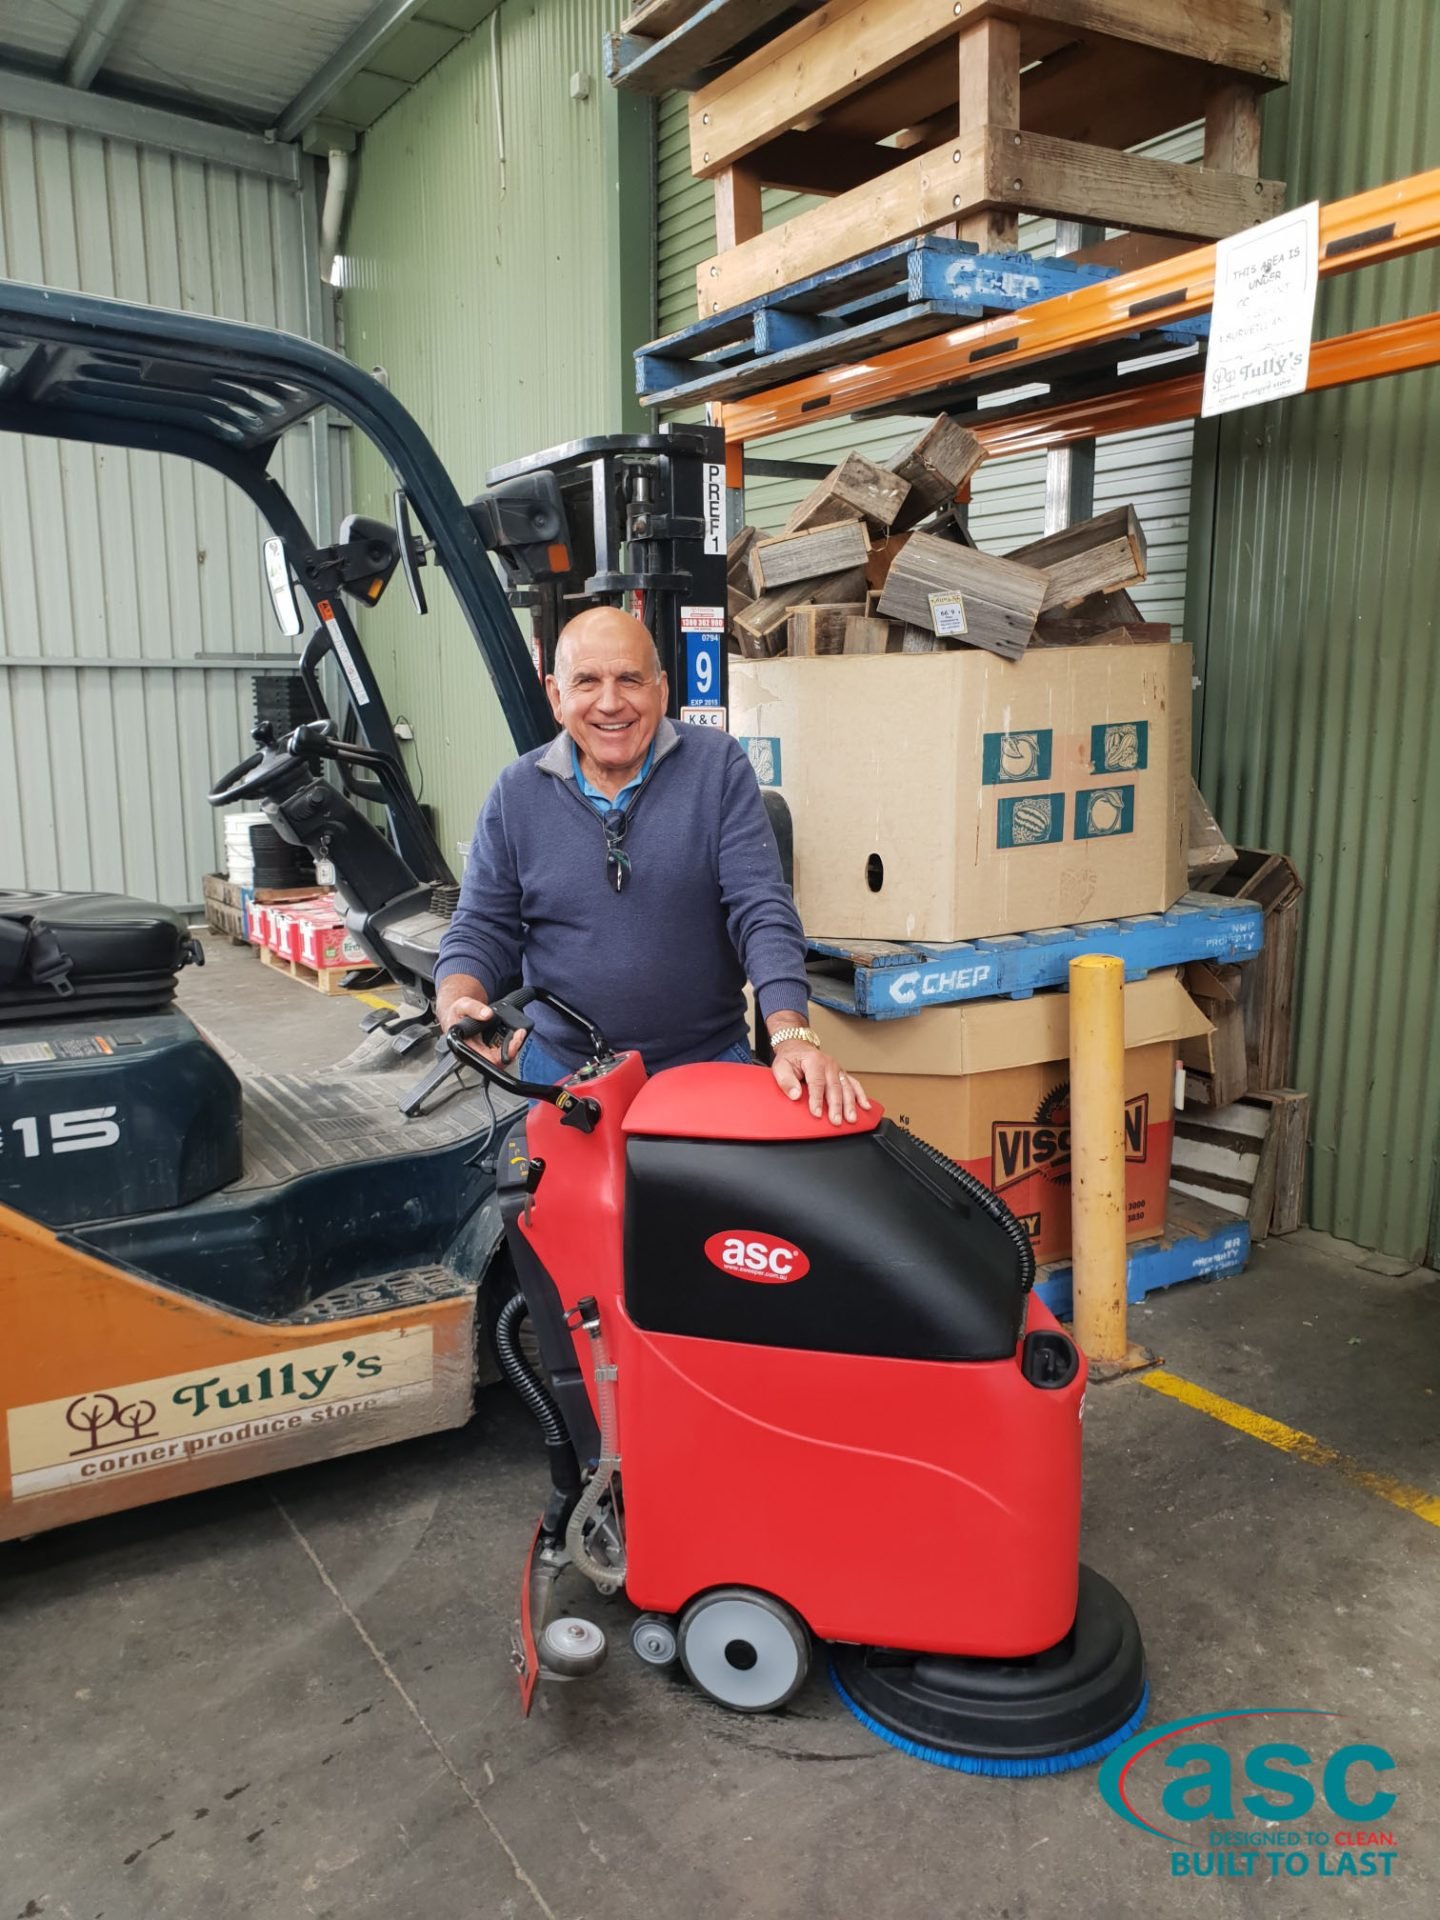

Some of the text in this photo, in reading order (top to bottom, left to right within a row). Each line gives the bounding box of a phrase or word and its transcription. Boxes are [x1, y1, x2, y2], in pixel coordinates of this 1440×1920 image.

[1233, 246, 1300, 280] THIS AREA IS
[702, 634, 718, 642] 0794
[696, 651, 712, 693] 9
[689, 714, 717, 725] K & C
[922, 965, 991, 995] CHEP
[12, 1105, 121, 1158] 15
[172, 1350, 382, 1416] Tully's
[80, 1398, 377, 1477] corner produce store
